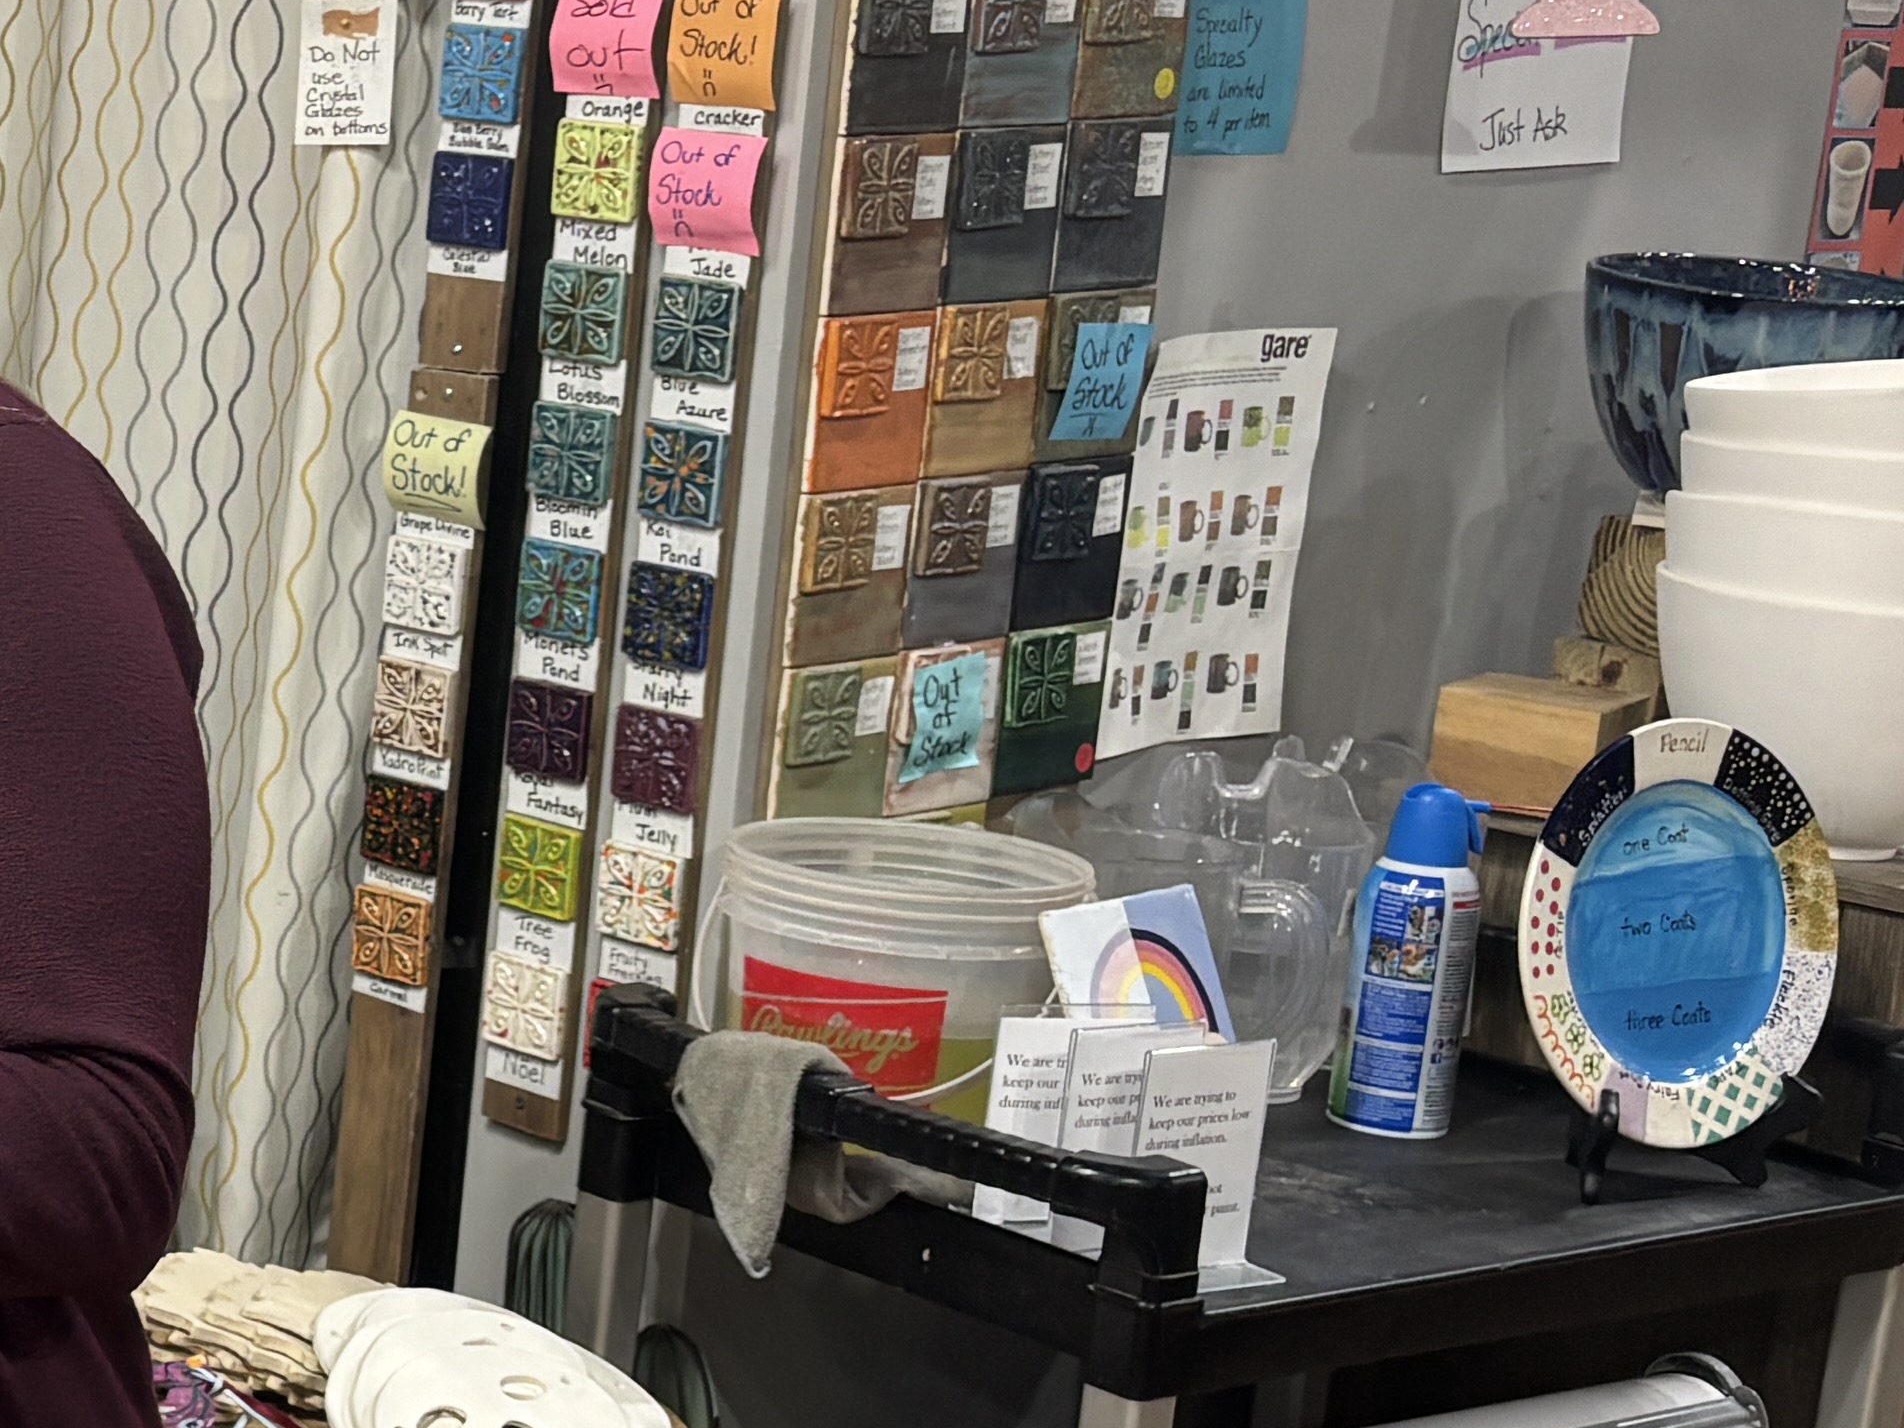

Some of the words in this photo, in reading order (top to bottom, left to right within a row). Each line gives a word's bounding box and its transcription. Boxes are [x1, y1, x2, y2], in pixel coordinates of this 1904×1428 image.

[1196, 7, 1263, 48] Specialty
[309, 47, 335, 63] Do
[343, 40, 381, 62] Not
[679, 28, 757, 65] Stock!
[1195, 45, 1246, 69] Glazes
[311, 72, 344, 85] use
[1479, 107, 1525, 151] Just
[1533, 105, 1568, 142] Ask
[661, 141, 705, 164] Out
[714, 144, 741, 167] of
[655, 174, 722, 208] Stock
[573, 246, 627, 271] Melon
[691, 258, 736, 278] Jade
[1081, 339, 1112, 369] Out
[1260, 333, 1309, 362] gare
[556, 383, 620, 408] Blossom
[1071, 376, 1128, 411] Stock
[675, 400, 728, 422] Azure
[393, 419, 436, 448] Out
[443, 426, 472, 452] of
[391, 456, 467, 499] Stock!
[550, 521, 594, 540] Blue
[660, 546, 701, 568] Pond
[542, 657, 580, 682] Pond
[642, 683, 692, 709] Night
[923, 669, 963, 708] Out
[914, 735, 970, 768] Stock
[527, 793, 584, 825] Fantasy
[635, 824, 678, 852] Jelly
[514, 916, 554, 940] Tree
[514, 937, 551, 965] Frog
